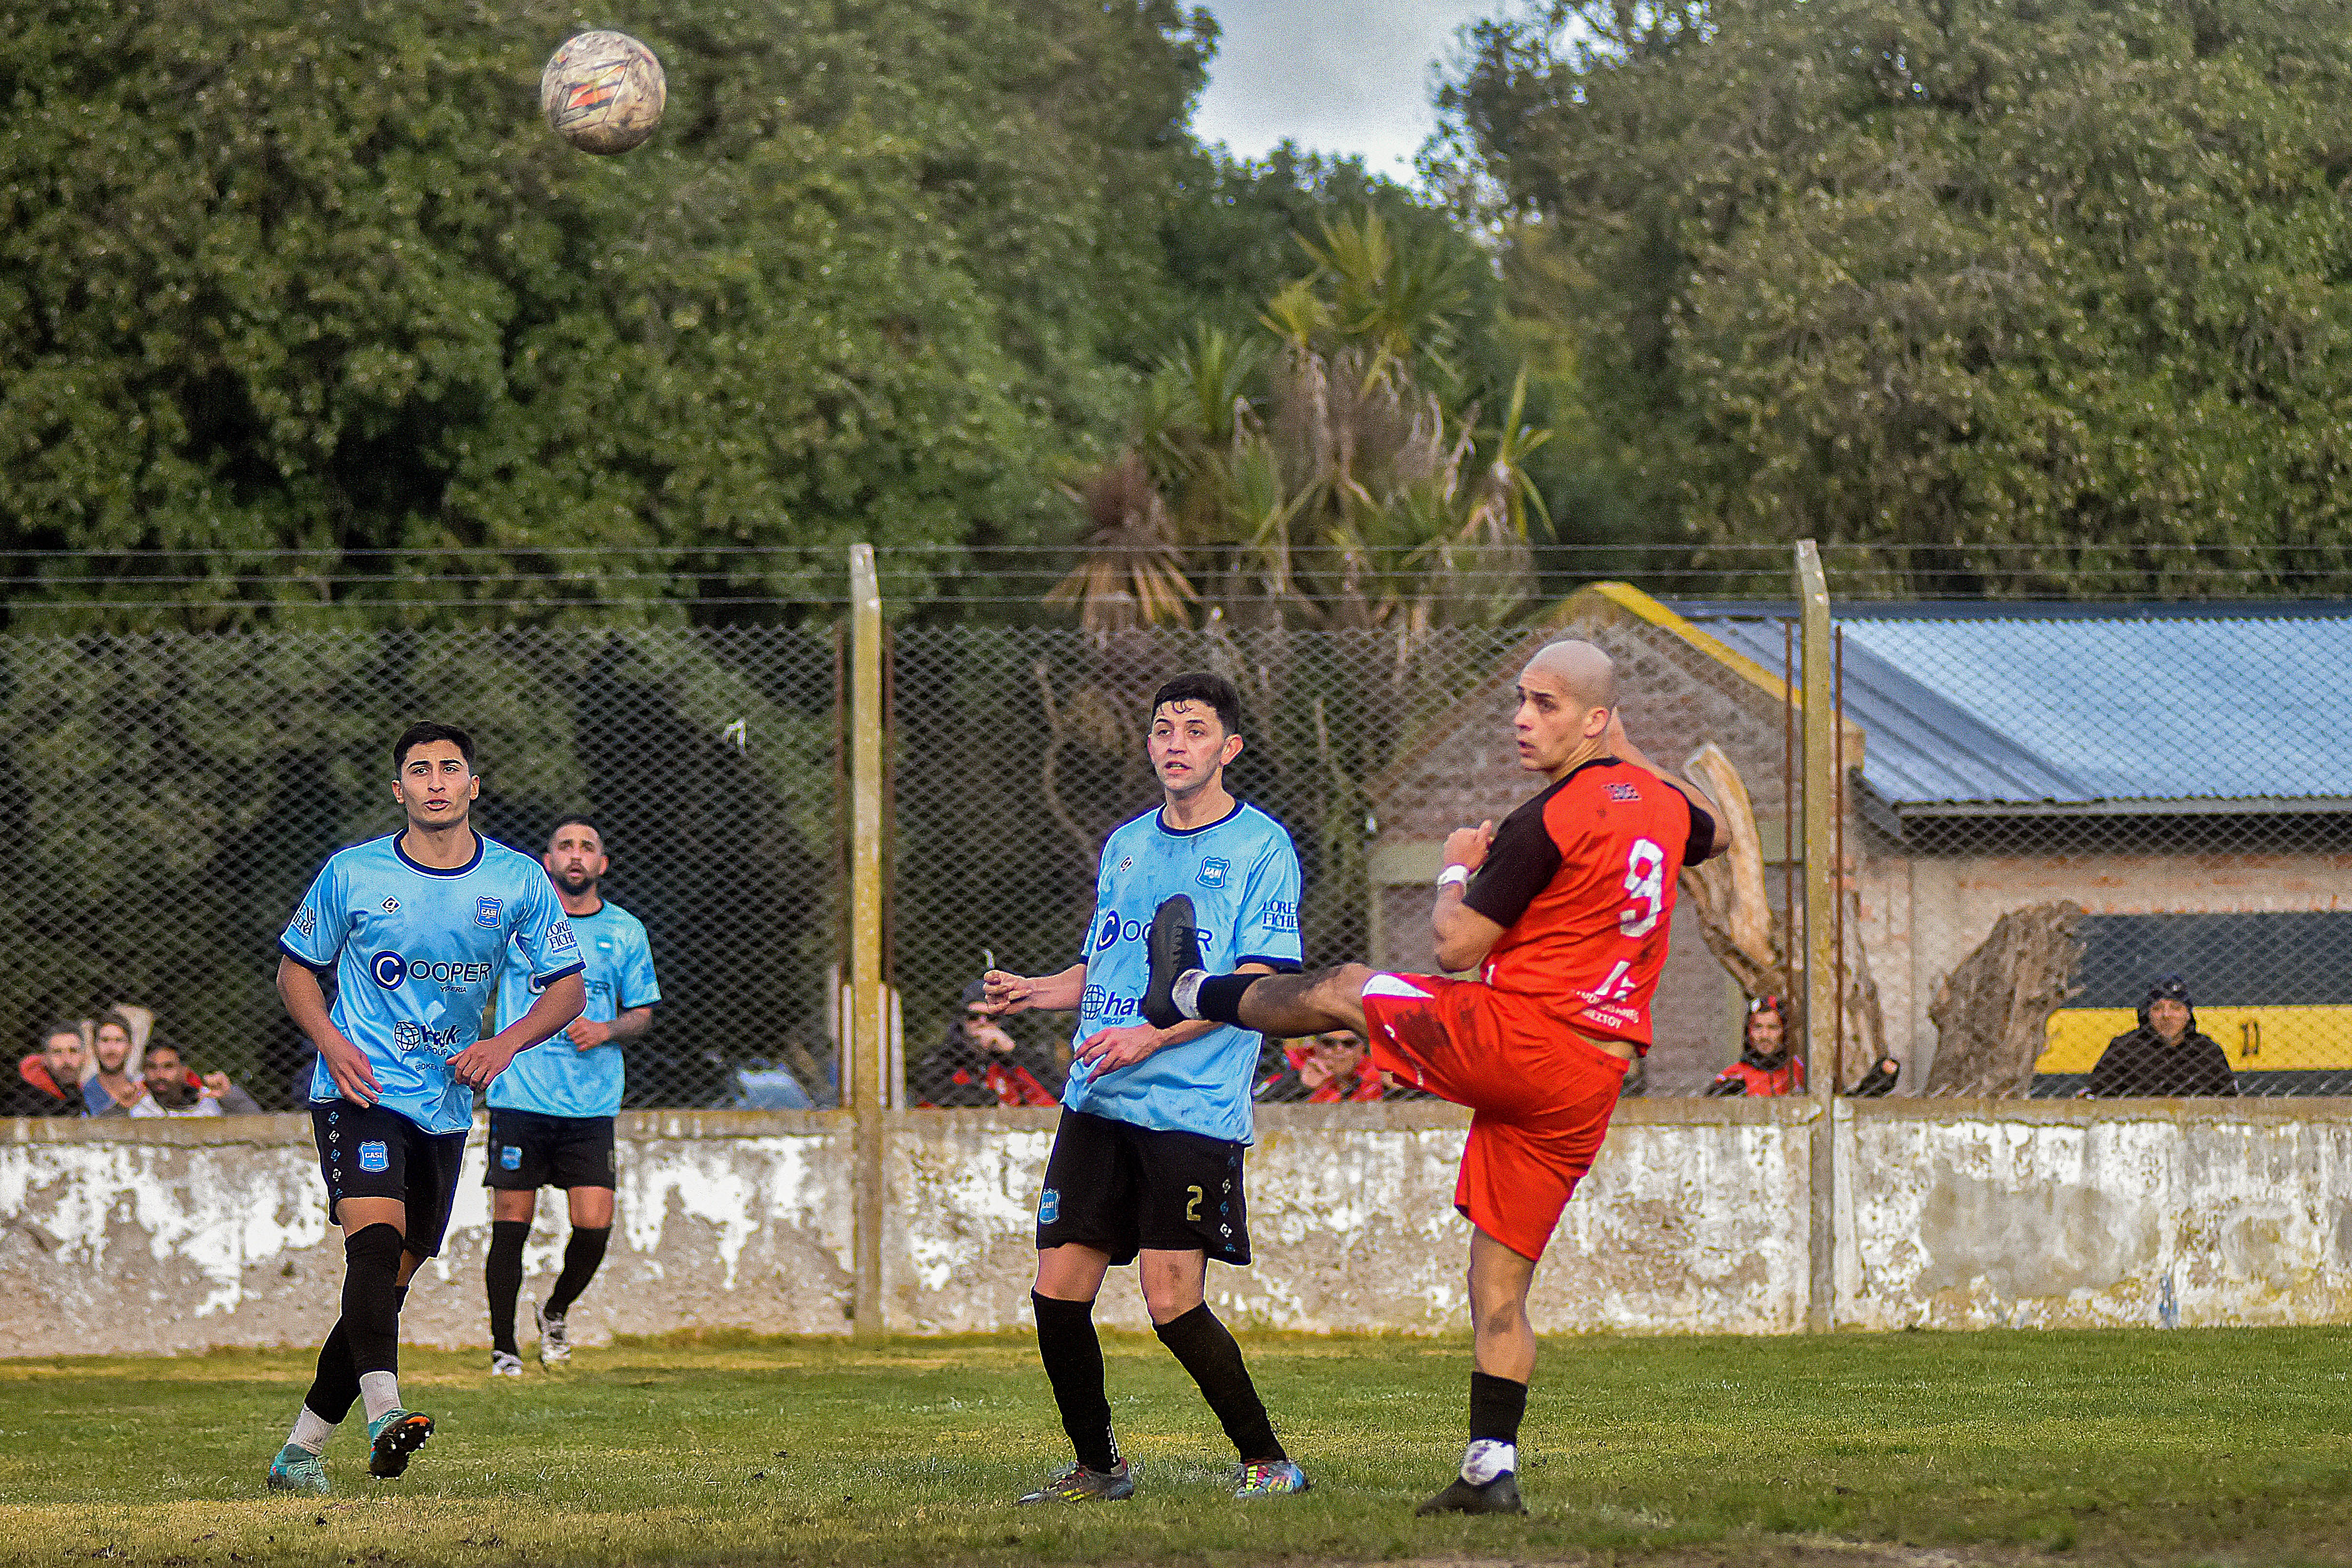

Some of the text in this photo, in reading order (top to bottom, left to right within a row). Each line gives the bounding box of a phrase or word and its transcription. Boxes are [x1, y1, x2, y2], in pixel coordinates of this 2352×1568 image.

[1620, 839, 1664, 937] 9
[373, 954, 492, 987] COOPER
[1187, 1185, 1203, 1221] 2
